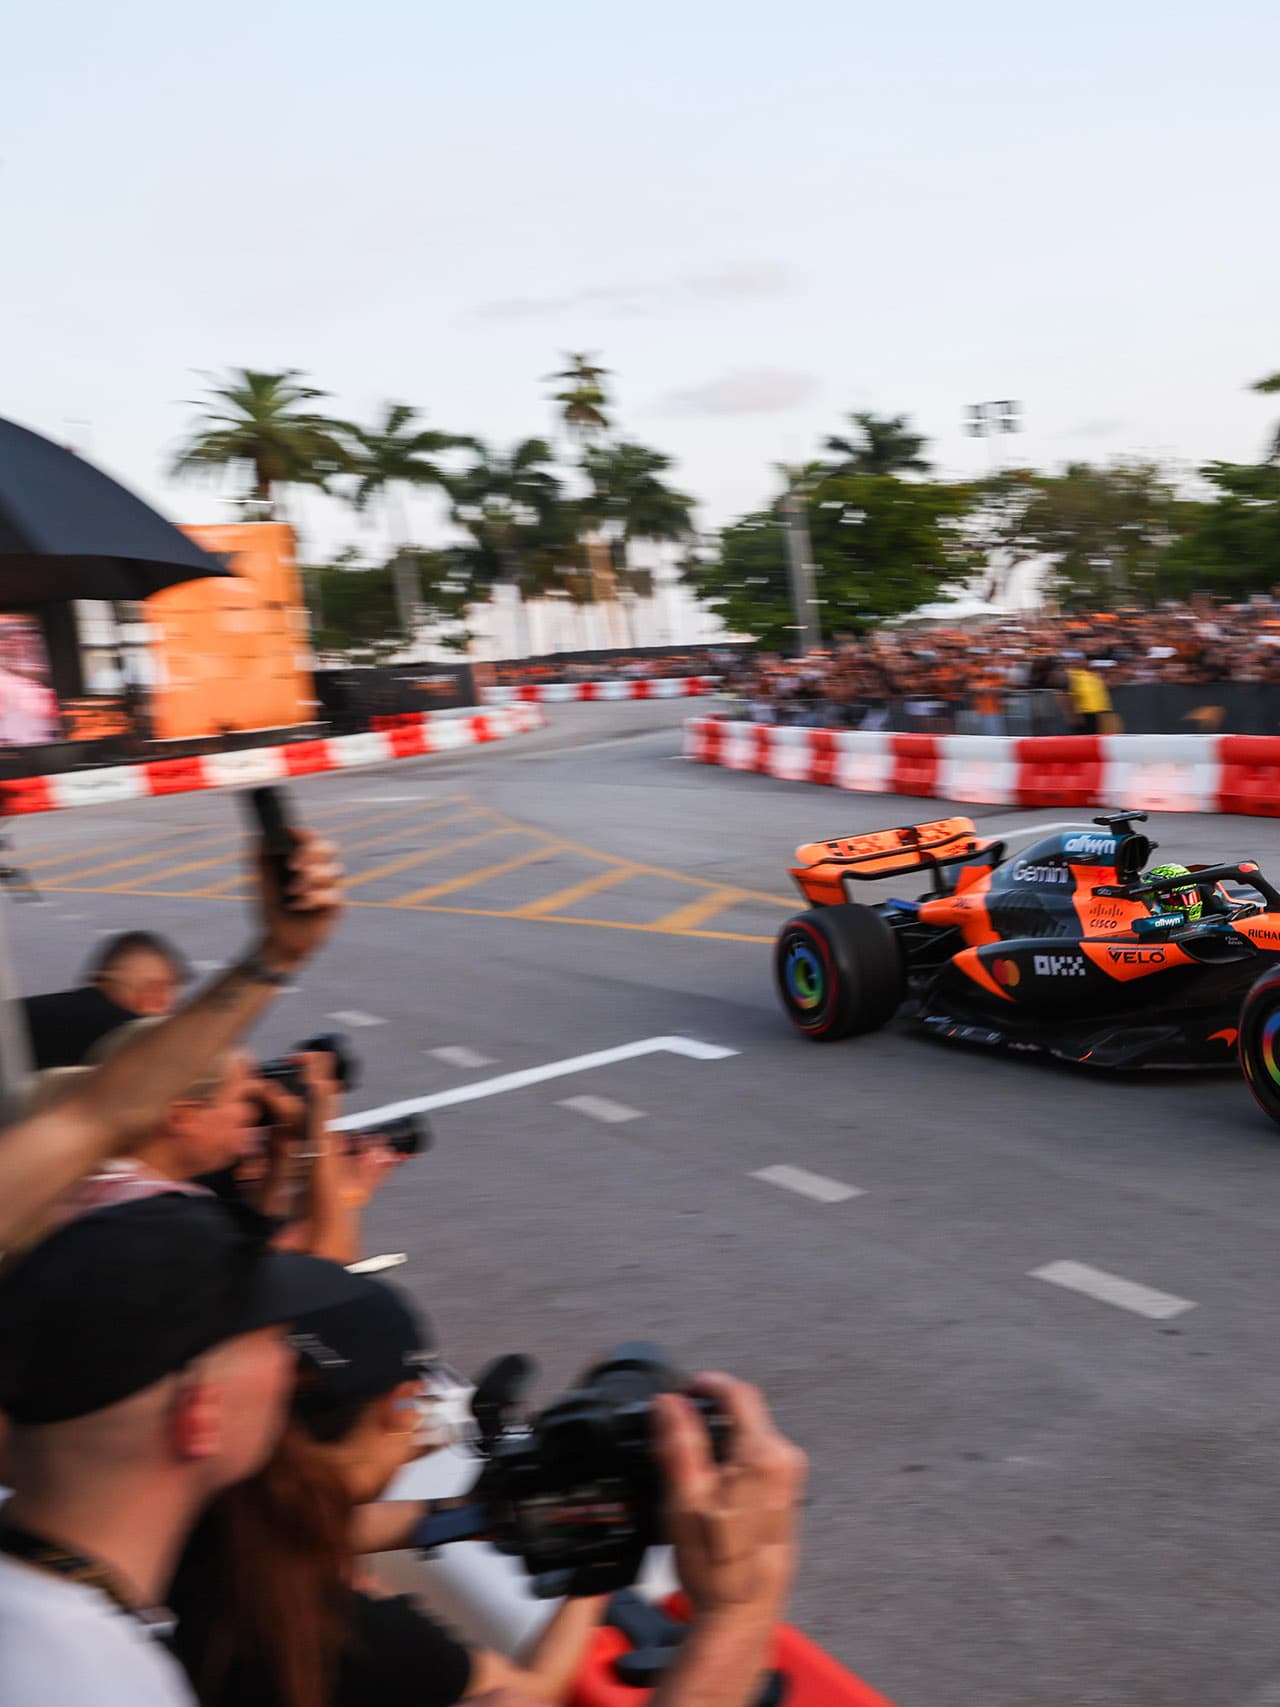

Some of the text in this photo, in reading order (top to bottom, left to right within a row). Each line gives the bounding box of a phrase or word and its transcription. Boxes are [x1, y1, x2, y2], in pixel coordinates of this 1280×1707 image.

[1013, 860, 1068, 883] Gemini
[1090, 919, 1118, 929] CISCO
[1108, 951, 1166, 964] VELO
